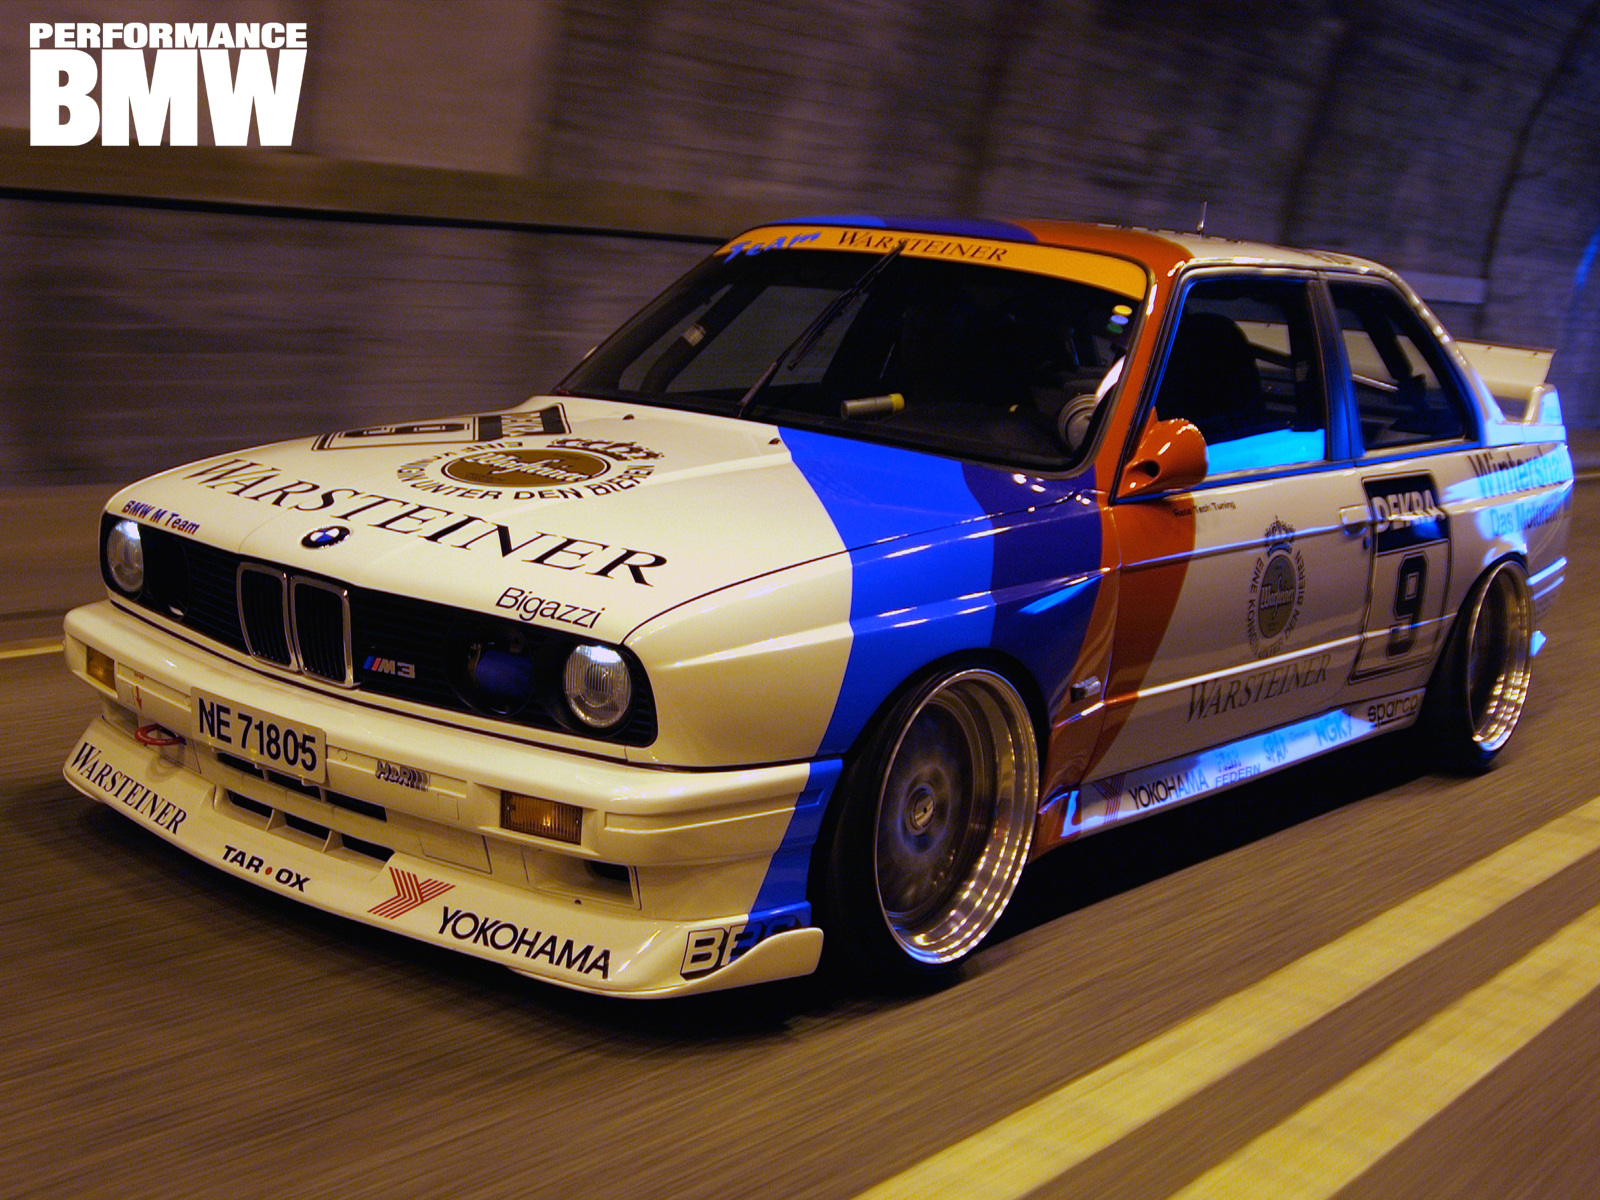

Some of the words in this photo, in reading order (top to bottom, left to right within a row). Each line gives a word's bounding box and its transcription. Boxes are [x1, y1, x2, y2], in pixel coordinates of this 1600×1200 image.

[410, 479, 503, 500] UNTER
[513, 488, 585, 499] DEN
[1467, 443, 1569, 499] Wintershall
[121, 500, 155, 519] BMW
[149, 508, 168, 523] M
[164, 513, 200, 535] Team
[182, 459, 668, 587] WARSTEINER
[1193, 504, 1211, 513] Tech
[1211, 501, 1236, 510] Tuning
[1372, 489, 1446, 533] DEKRA
[1490, 507, 1515, 537] Das
[495, 587, 606, 629] Bigazzi
[1386, 550, 1429, 658] 9
[1187, 653, 1331, 723] WARSTEINER
[1314, 712, 1349, 746] NGK
[1368, 695, 1418, 729] sparco
[198, 697, 232, 744] NE
[238, 712, 317, 772] 71805
[69, 741, 188, 835] WARSTEINER
[1128, 768, 1209, 809] YOKOHAMA
[1215, 763, 1261, 790] FEDERN
[438, 905, 612, 980] YOKOHAMA
